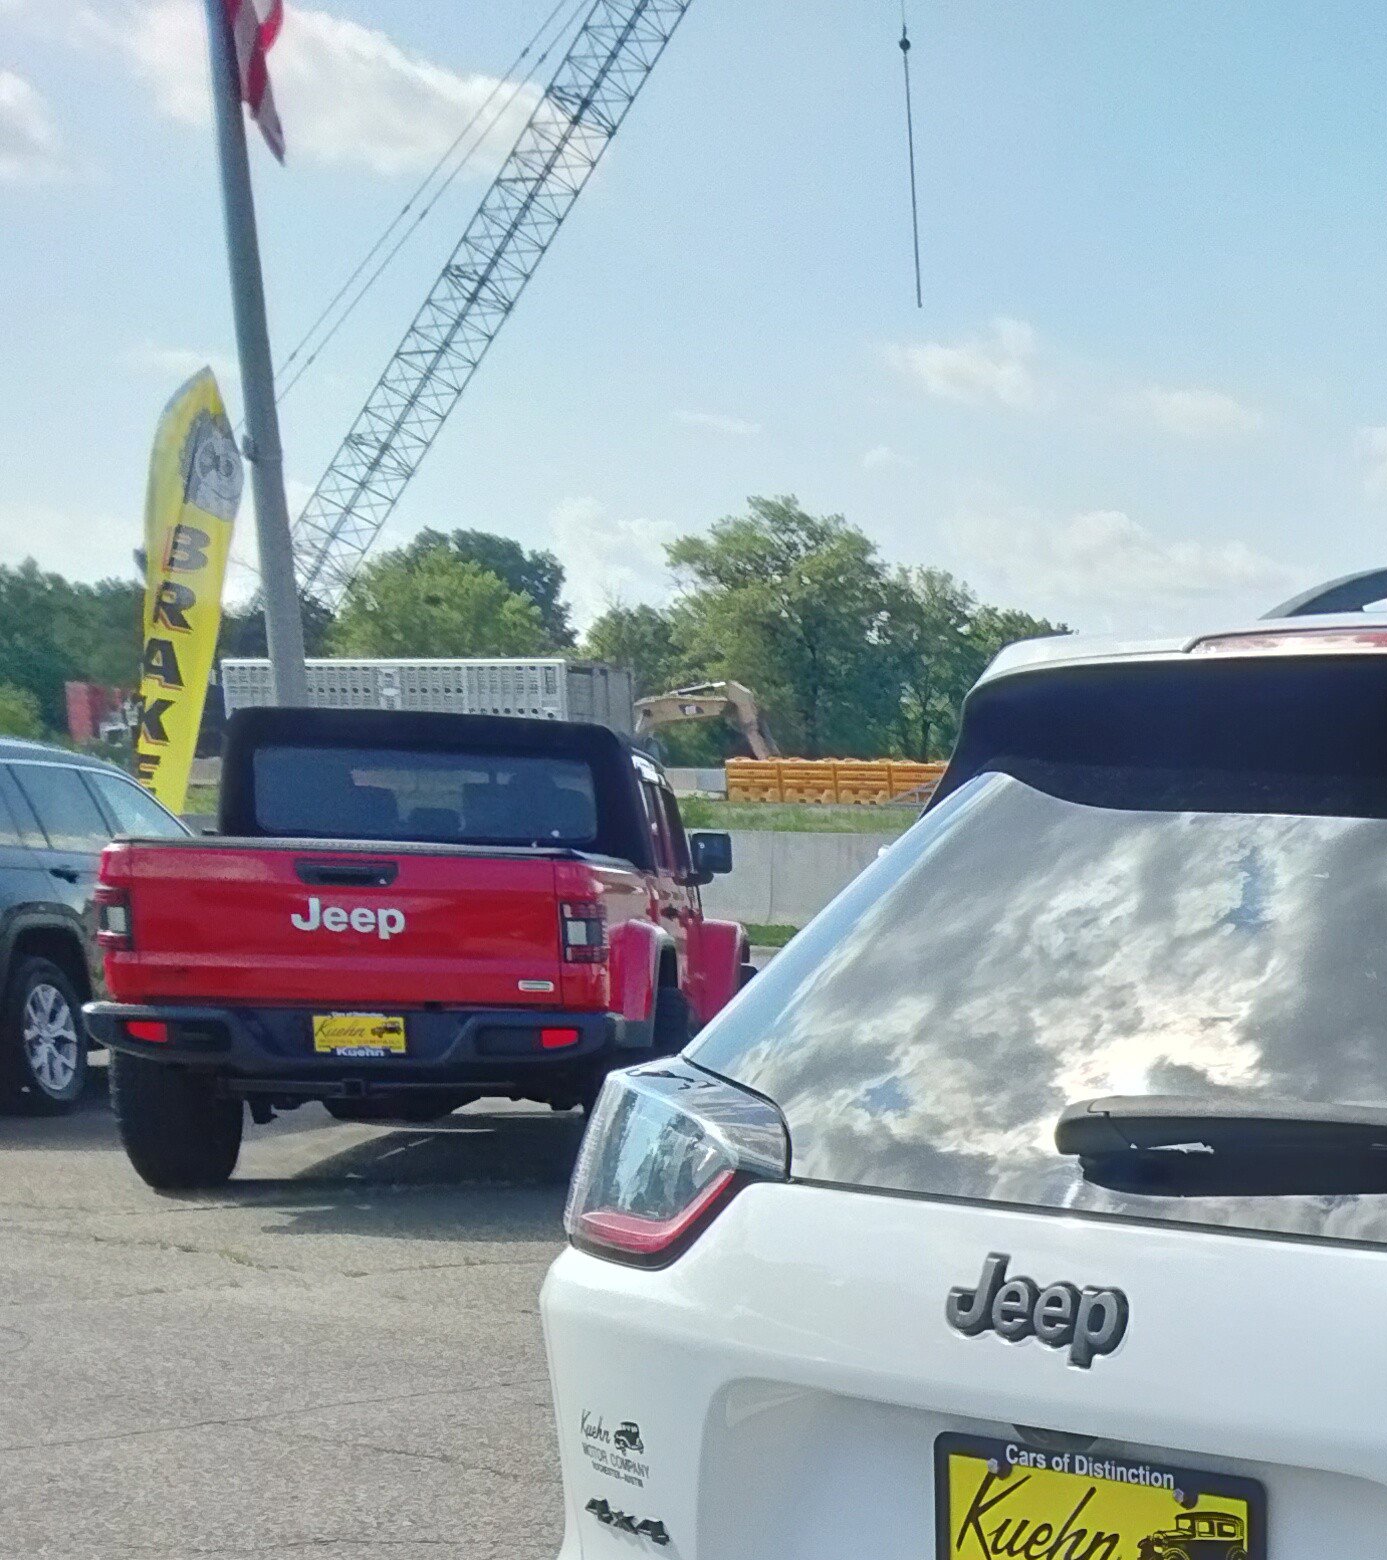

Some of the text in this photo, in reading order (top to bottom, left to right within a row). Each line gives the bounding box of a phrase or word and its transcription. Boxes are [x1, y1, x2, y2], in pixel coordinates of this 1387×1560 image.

[290, 896, 407, 940] Jeep
[335, 1046, 385, 1057] Kuehn
[944, 1251, 1130, 1370] Jeep
[1005, 1443, 1175, 1491] Cars of Distinction
